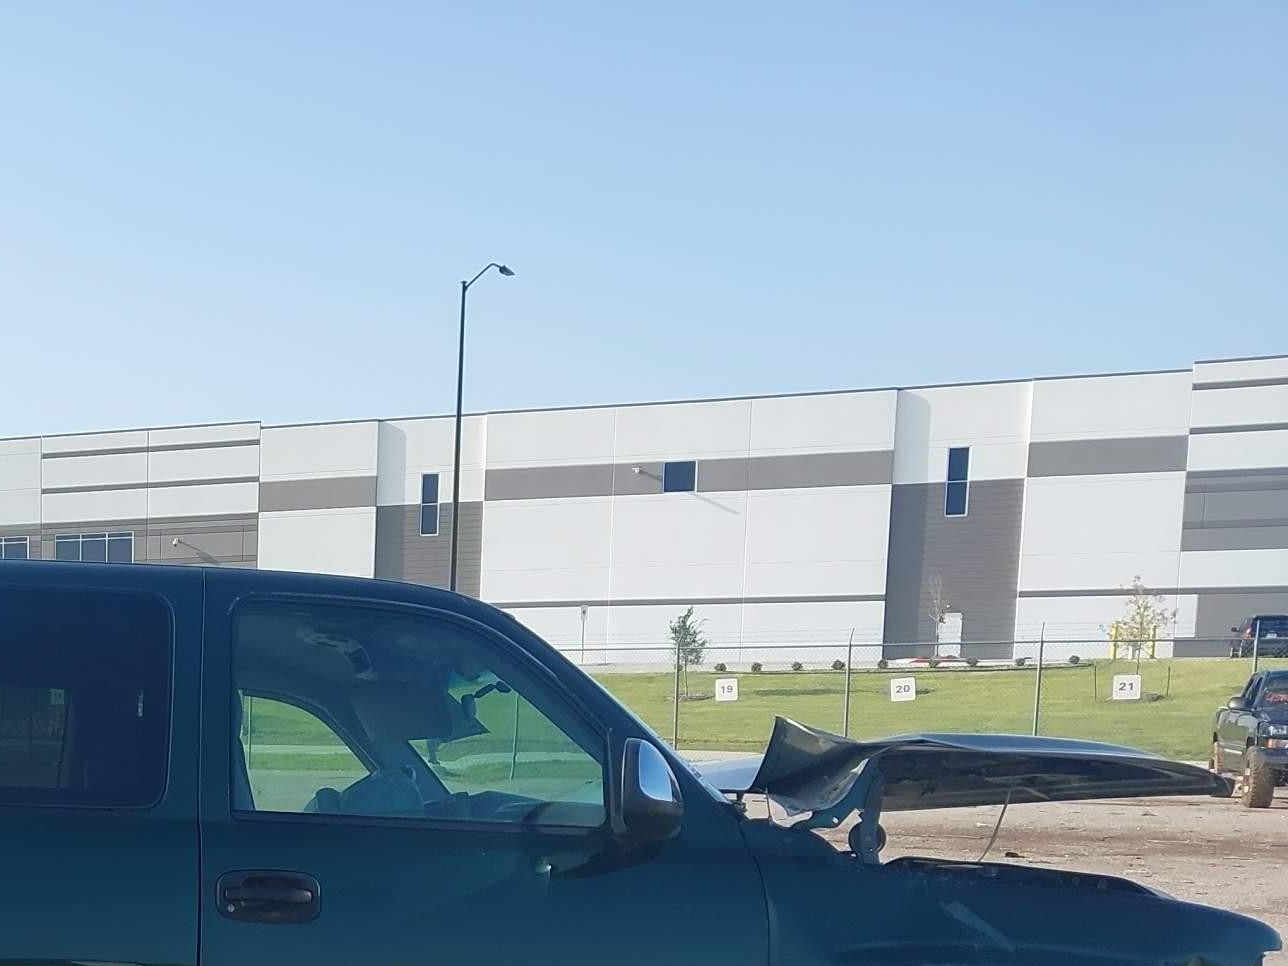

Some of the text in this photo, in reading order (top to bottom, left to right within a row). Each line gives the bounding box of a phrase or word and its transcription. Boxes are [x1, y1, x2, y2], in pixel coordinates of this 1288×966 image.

[721, 685, 733, 694] 19
[896, 684, 910, 694] 20
[1119, 682, 1133, 691] 21
